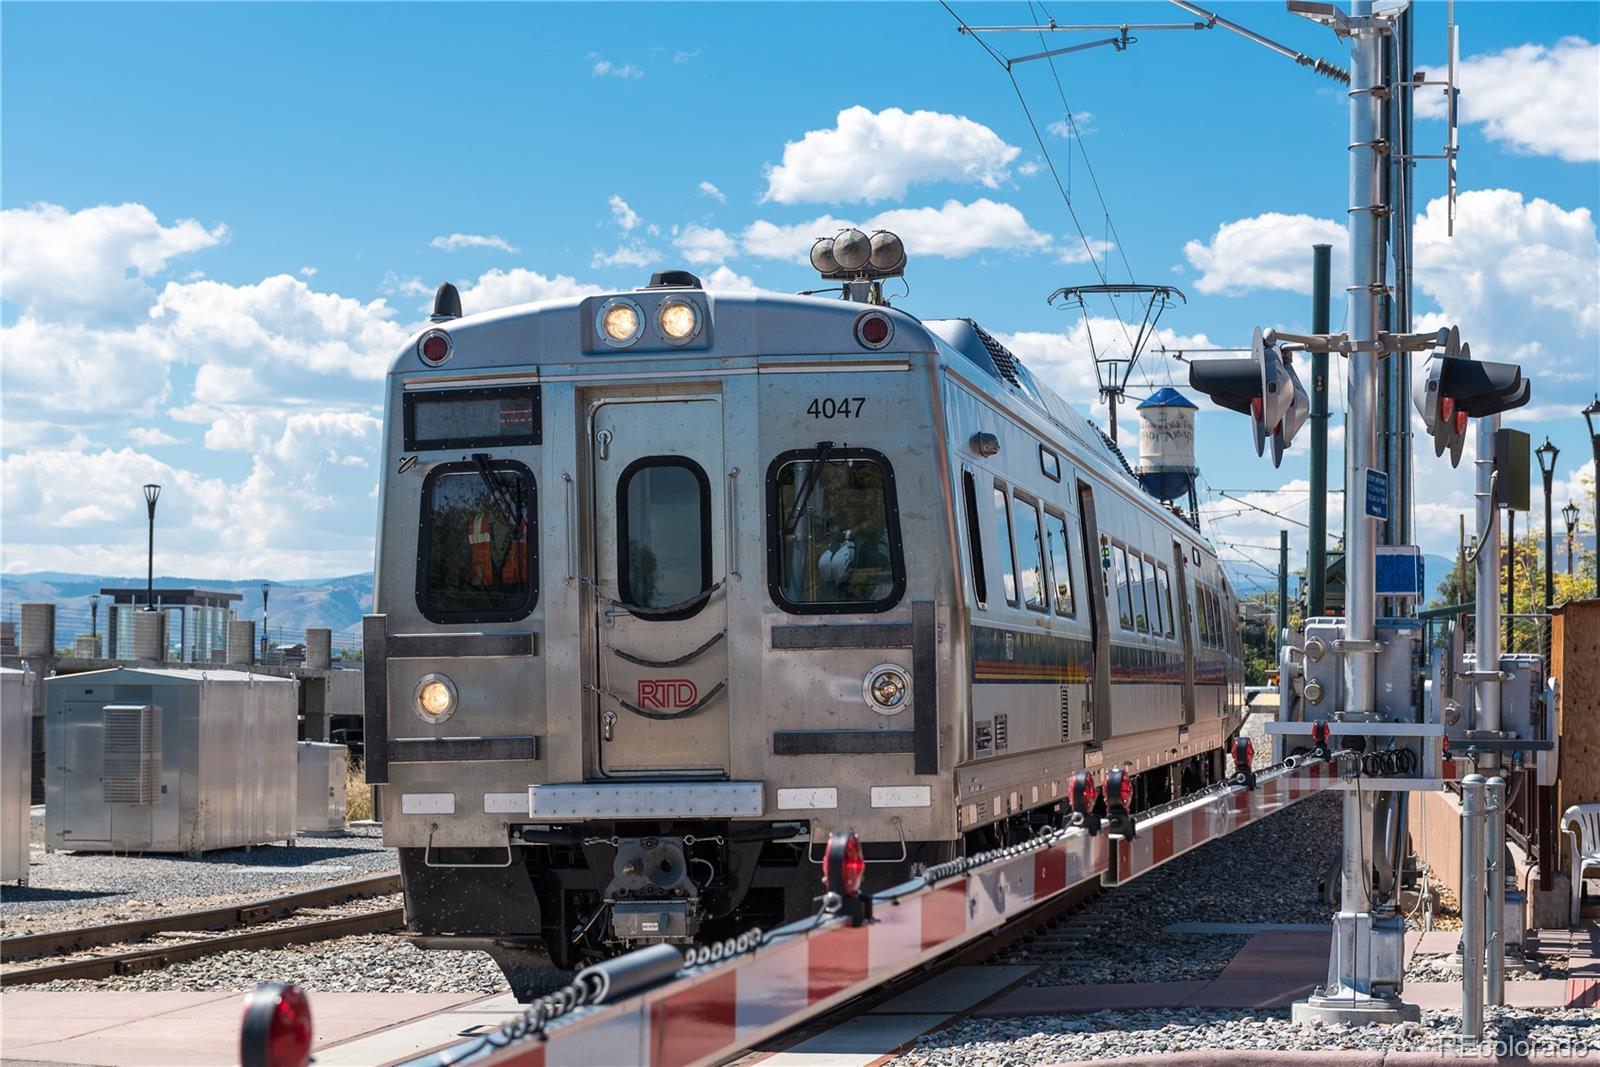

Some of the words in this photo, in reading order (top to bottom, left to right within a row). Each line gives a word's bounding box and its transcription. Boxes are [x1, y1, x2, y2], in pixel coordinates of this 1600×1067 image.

[806, 397, 867, 419] 4047
[1383, 557, 1407, 571] MP
[638, 679, 698, 708] RTD
